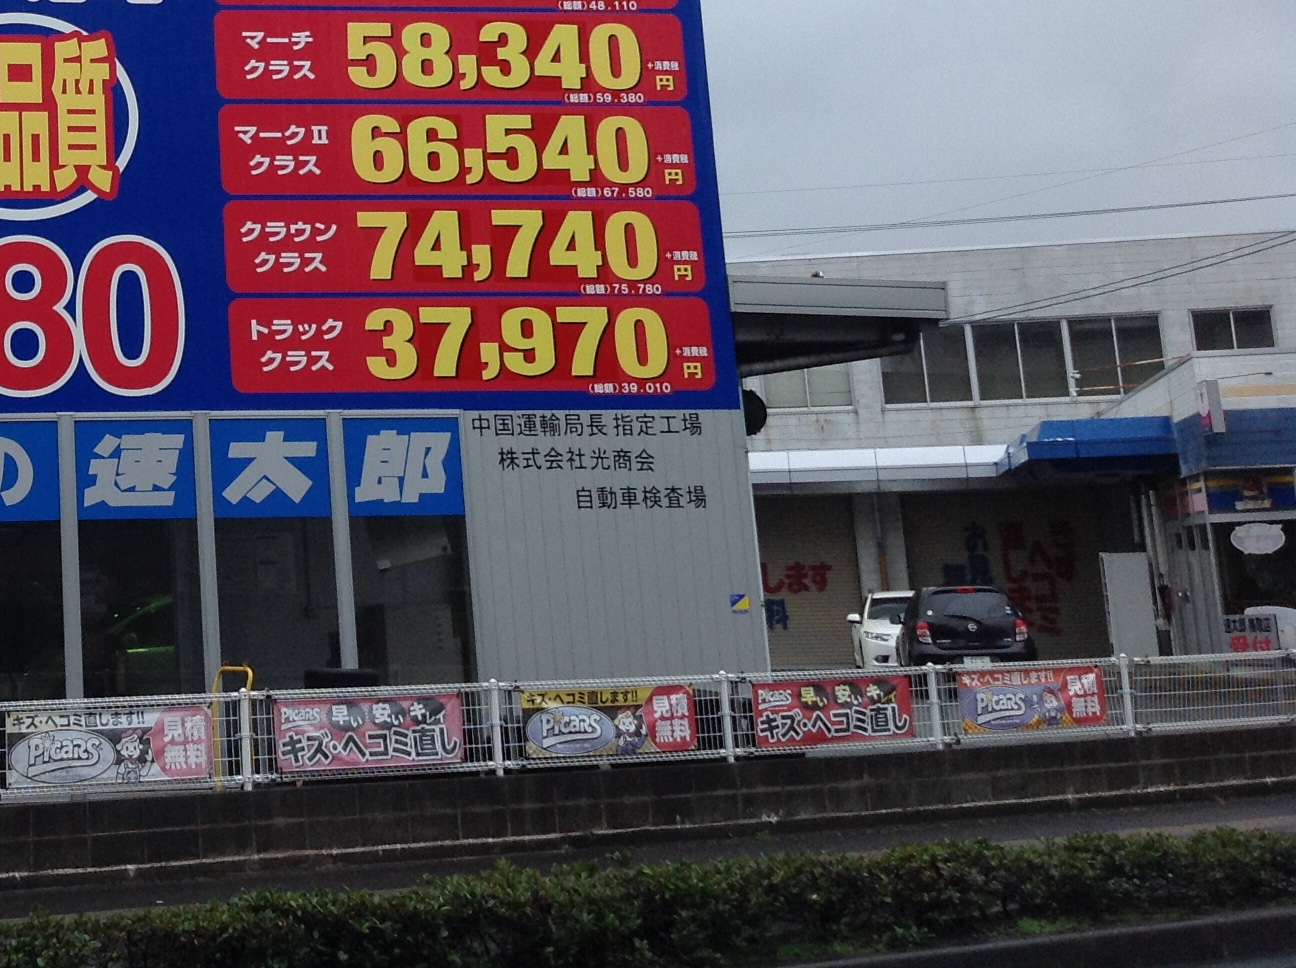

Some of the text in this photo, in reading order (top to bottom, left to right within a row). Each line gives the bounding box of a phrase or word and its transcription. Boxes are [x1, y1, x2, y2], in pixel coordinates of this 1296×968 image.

[241, 31, 314, 50] マーチ
[346, 21, 642, 92] 58,340
[244, 60, 316, 80] クラス
[655, 75, 675, 92] 円
[350, 113, 650, 185] 66,540
[248, 155, 322, 176] クラス
[664, 168, 683, 185] 円
[239, 220, 338, 243] クラウン
[356, 209, 659, 282] 74,740
[254, 252, 328, 274] クラス
[673, 264, 693, 281] 円
[249, 318, 344, 341] トラック
[364, 305, 670, 381] 37,970
[259, 350, 335, 373] クラス
[682, 362, 703, 379] 円
[498, 446, 656, 472] 株式会社光商会
[575, 485, 707, 510] 自動車検査場
[800, 686, 828, 706] 早い
[834, 684, 862, 705] 安い
[331, 704, 364, 727] 早い
[372, 702, 404, 726] 安い
[164, 743, 205, 770] 無料
